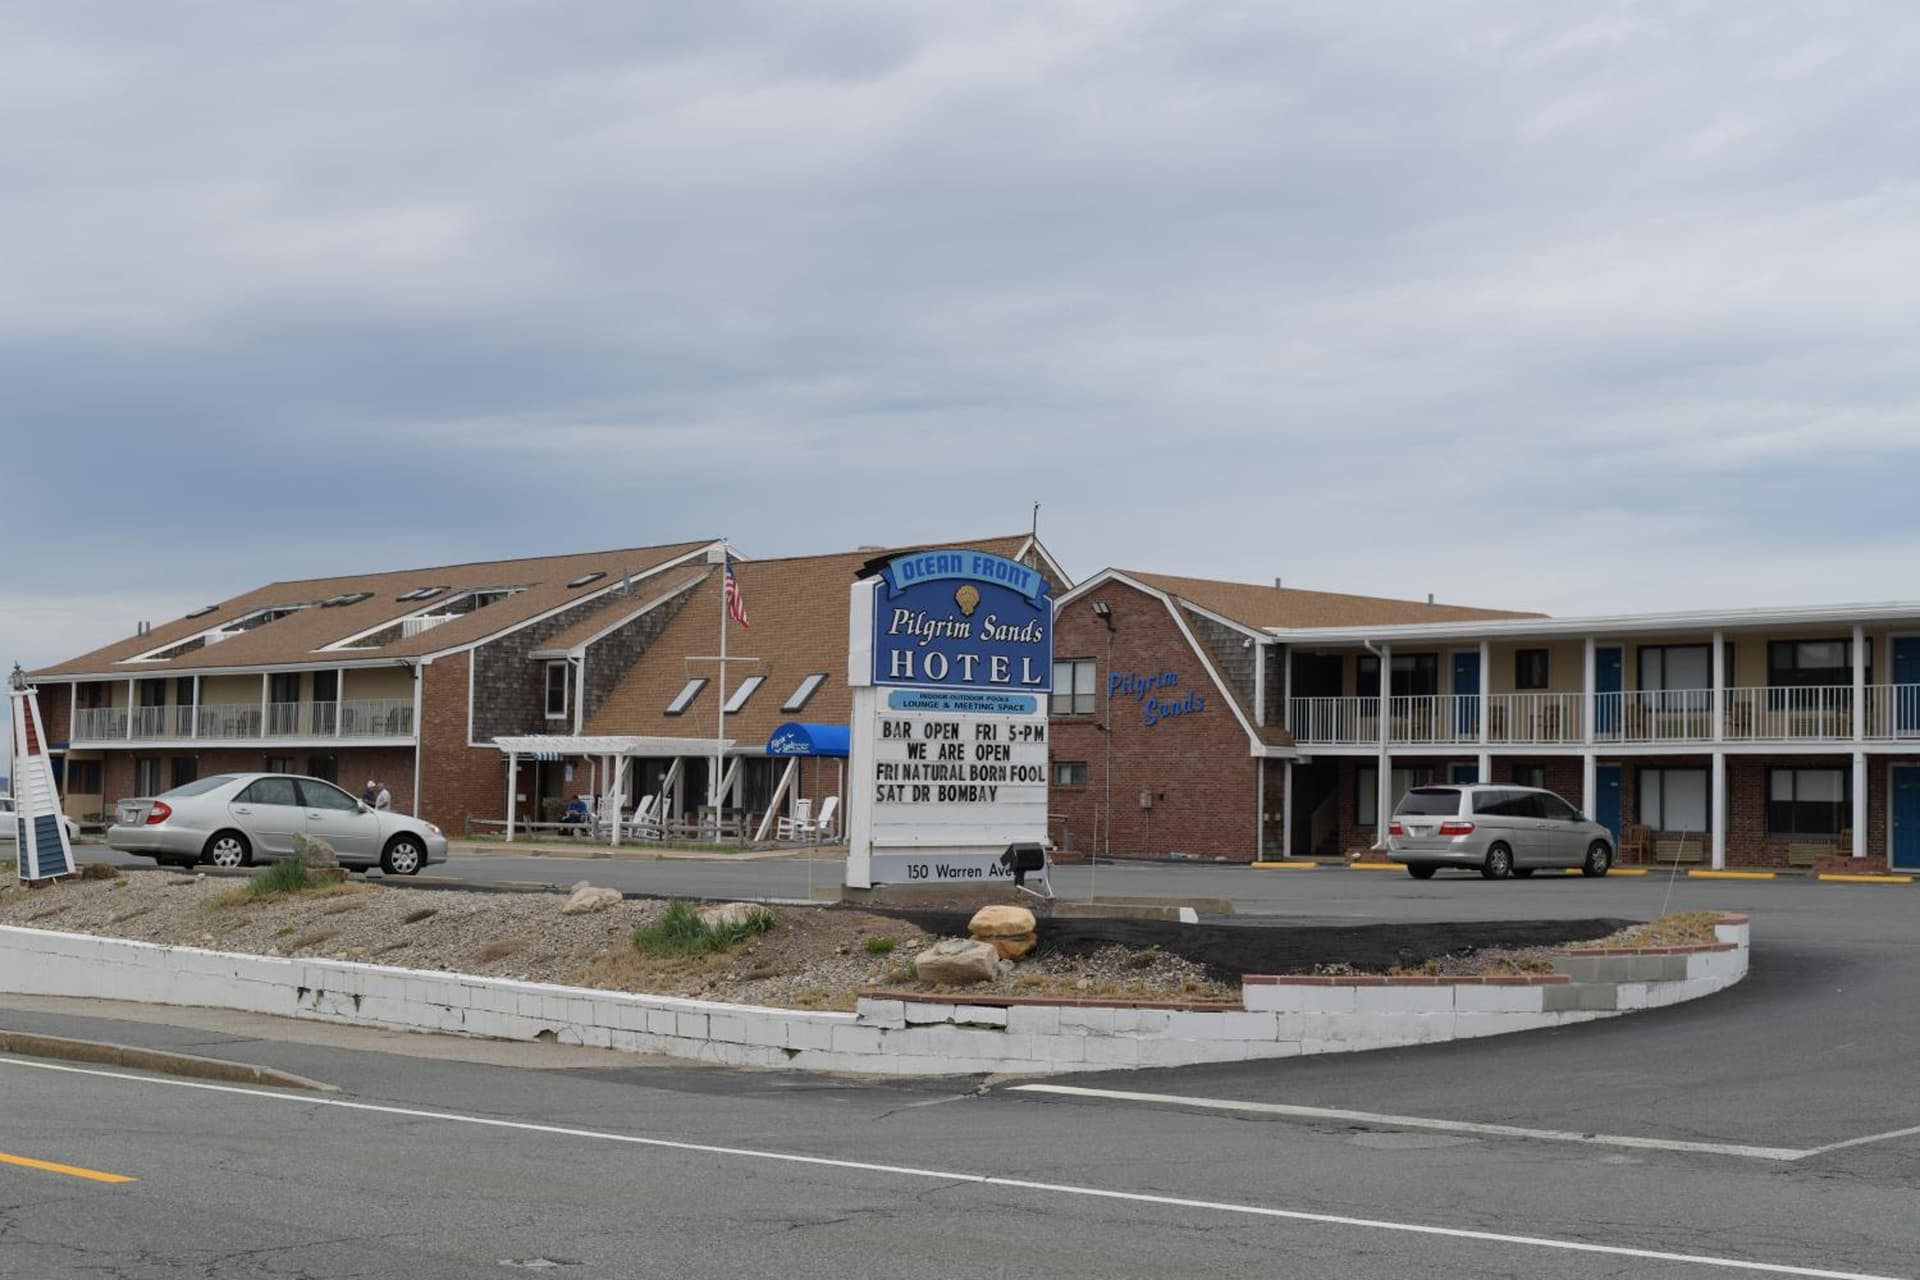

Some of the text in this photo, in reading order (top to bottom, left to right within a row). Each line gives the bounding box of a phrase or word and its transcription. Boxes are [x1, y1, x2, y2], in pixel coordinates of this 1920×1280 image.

[902, 554, 1031, 589] OCEAN FRONT
[888, 608, 1043, 646] Pilgrim Sands
[889, 649, 1042, 685] HOTEL
[1107, 669, 1179, 701] Pilgrim
[903, 700, 940, 709] LOUNGE
[954, 702, 994, 711] MEETING
[998, 704, 1025, 712] SPACE
[1143, 689, 1206, 728] Sands
[882, 721, 1045, 742] BAR OPEN FRI 5-PM
[907, 742, 1010, 761] WE ARE OPEN
[876, 763, 1046, 783] FRI NATURAL BORN FOOL
[876, 784, 998, 802] SAT DR BOMBAY
[907, 864, 929, 880] 150
[936, 864, 982, 878] Warren
